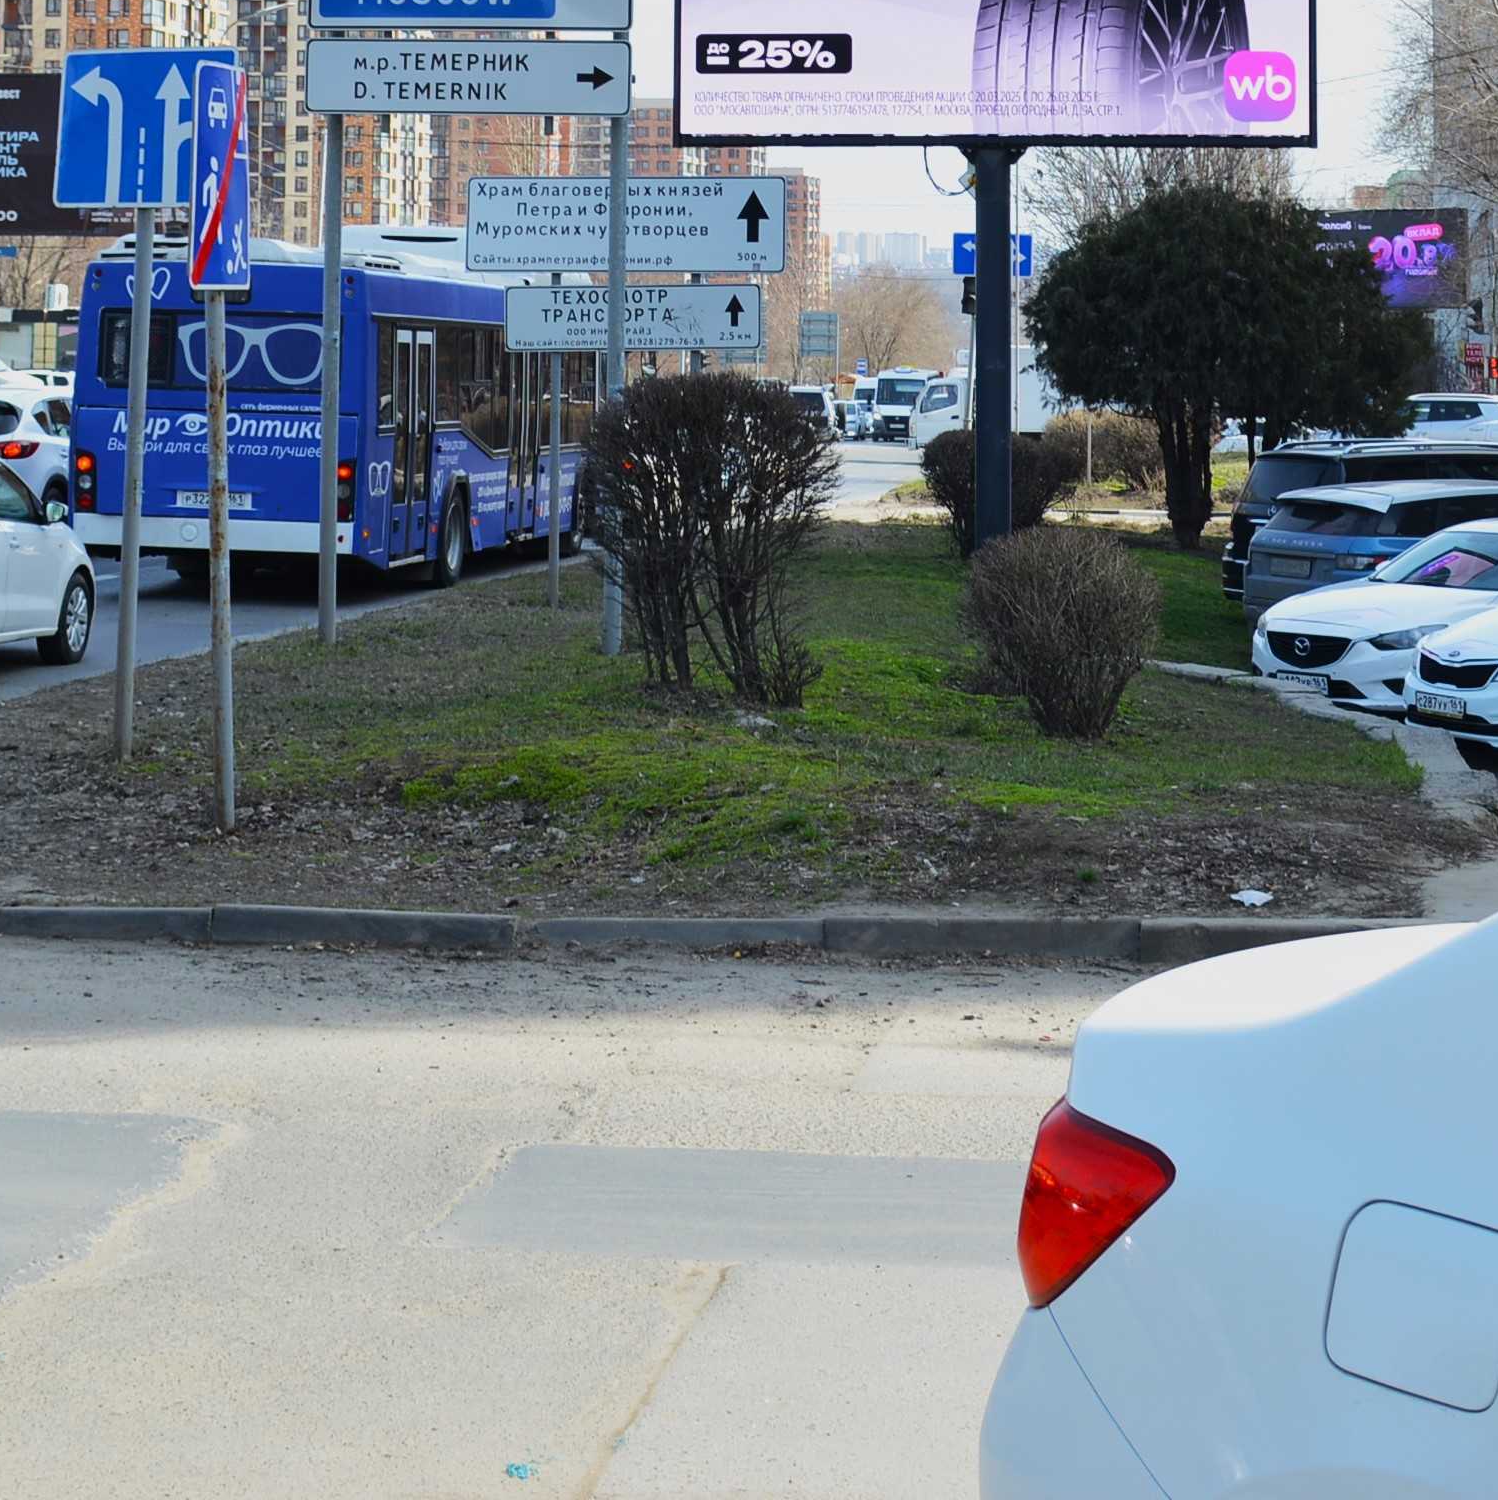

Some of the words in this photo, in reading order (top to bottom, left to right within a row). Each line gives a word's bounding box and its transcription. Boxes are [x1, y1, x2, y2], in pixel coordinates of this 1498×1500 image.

[354, 82, 375, 100] D.
[384, 81, 507, 101] TEMERNIK
[1229, 65, 1292, 101] wb
[477, 183, 522, 199] Храм
[529, 182, 651, 199] благоверых
[657, 183, 723, 197] князей
[517, 203, 572, 221] Петра
[578, 205, 587, 216] и
[594, 202, 693, 221] Фронии,
[475, 222, 581, 240] Муромских
[588, 223, 709, 240] чутворцев
[737, 253, 757, 261] 500
[542, 308, 674, 322] ТРАНСОРТА
[567, 328, 586, 336] ООО
[515, 339, 534, 347] Наш
[107, 437, 163, 454] Выри
[163, 442, 191, 454] для
[193, 443, 236, 455] свх
[237, 444, 268, 456] глаз
